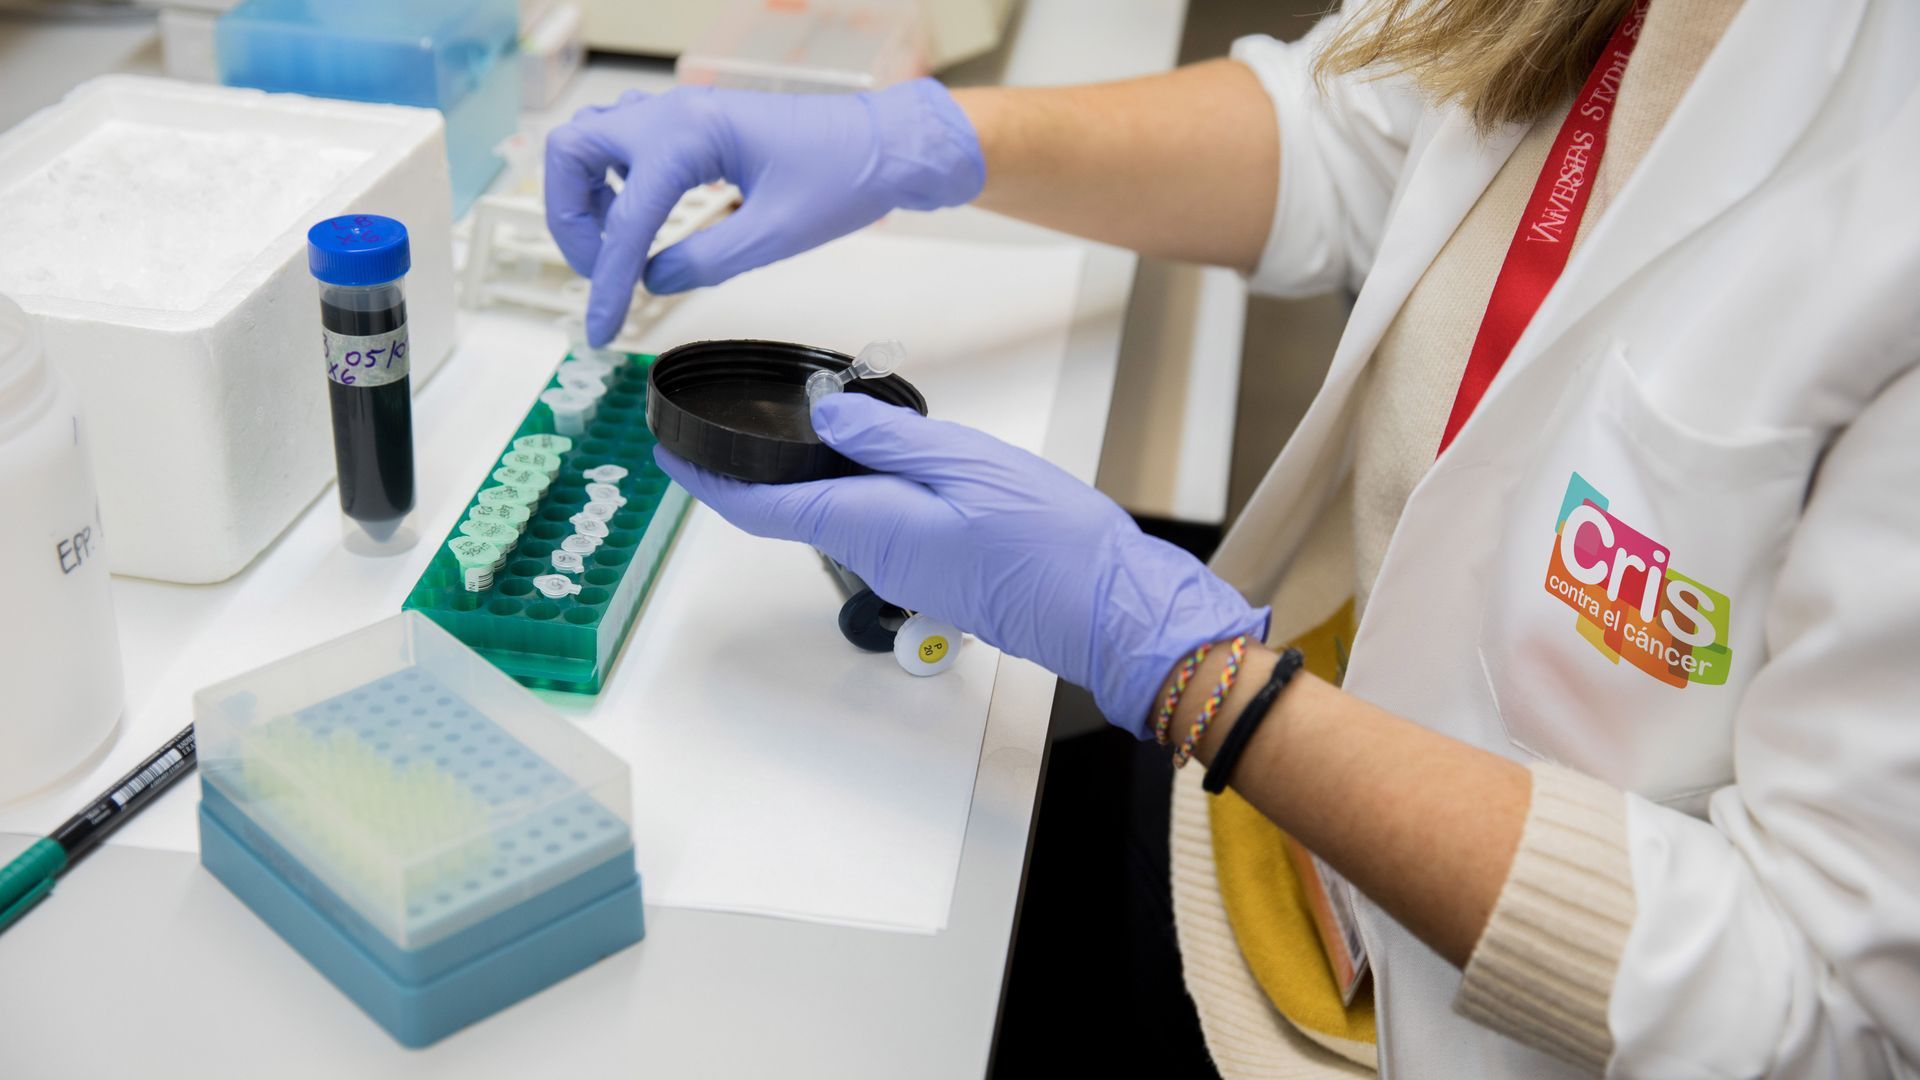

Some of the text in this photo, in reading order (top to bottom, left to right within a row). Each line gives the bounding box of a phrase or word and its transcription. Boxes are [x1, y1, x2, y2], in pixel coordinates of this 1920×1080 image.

[1560, 504, 1716, 648] Cris
[924, 644, 934, 656] 20
[934, 642, 942, 650] P
[1549, 575, 1712, 676] contra el cáncer
